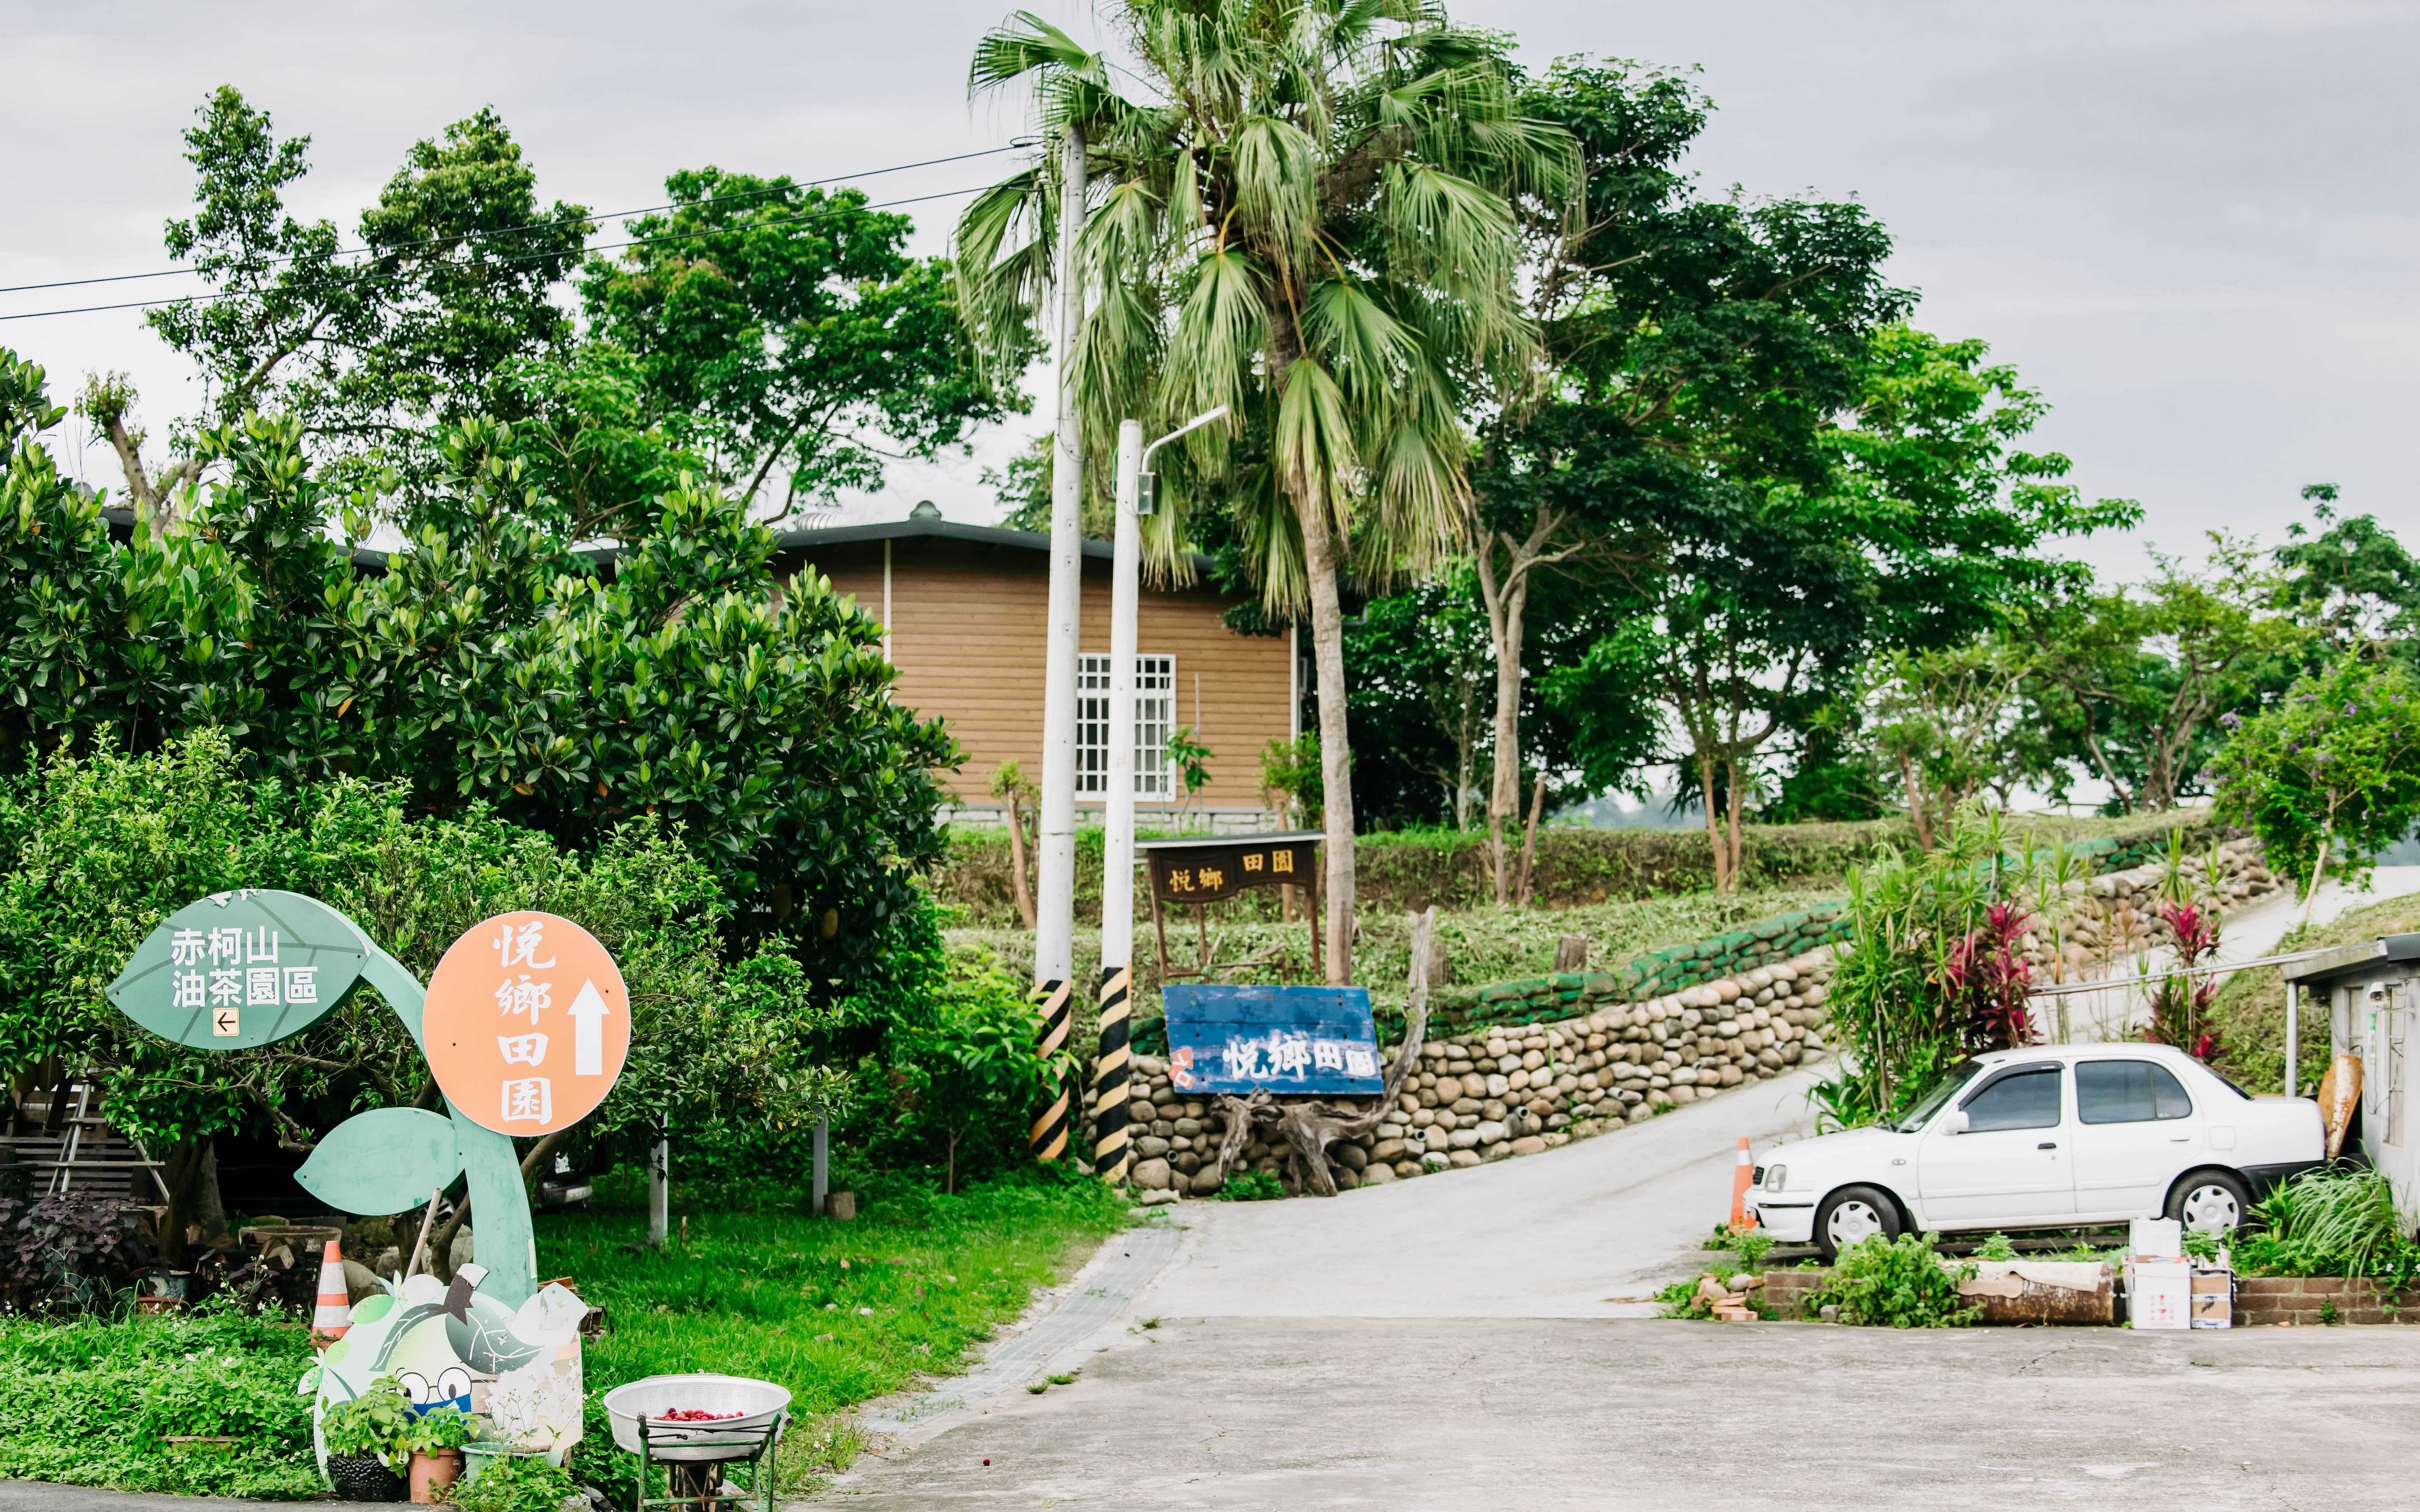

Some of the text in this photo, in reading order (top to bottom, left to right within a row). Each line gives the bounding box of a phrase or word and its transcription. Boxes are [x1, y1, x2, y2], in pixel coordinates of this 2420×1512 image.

[170, 925, 279, 967] 赤柯山
[172, 966, 319, 1008] 油茶園區
